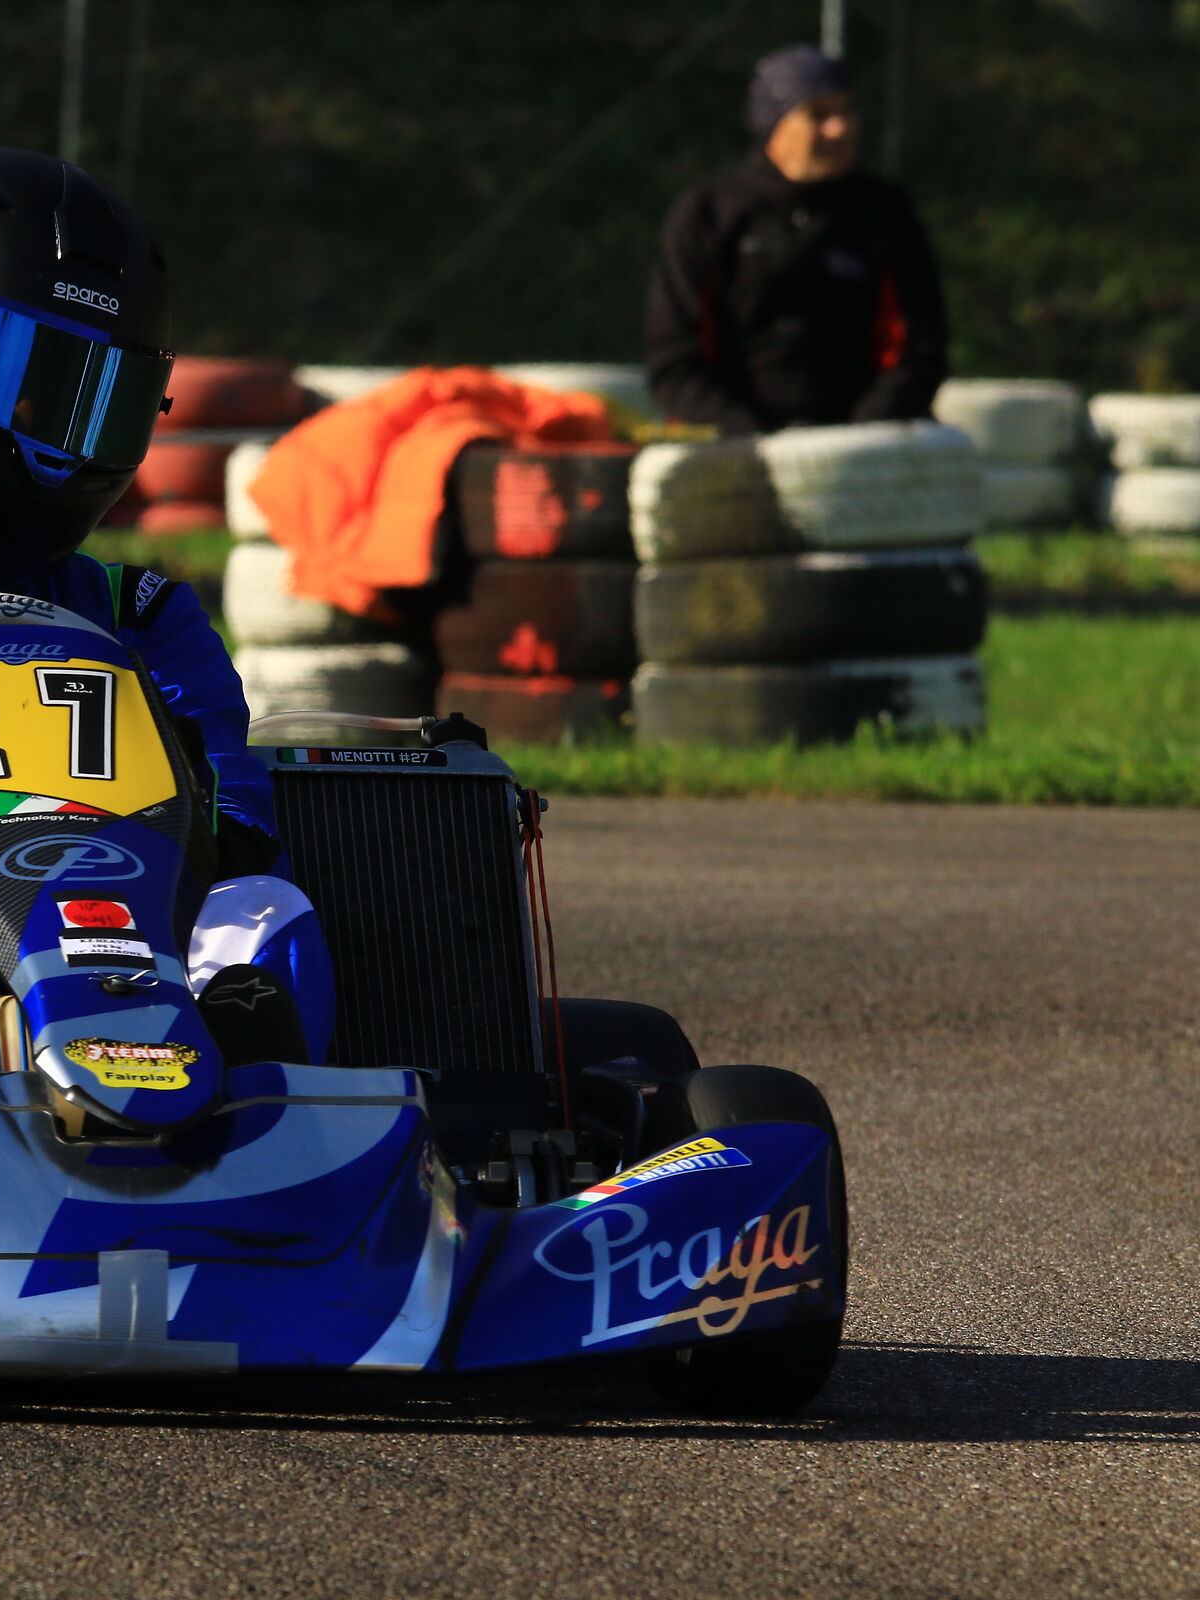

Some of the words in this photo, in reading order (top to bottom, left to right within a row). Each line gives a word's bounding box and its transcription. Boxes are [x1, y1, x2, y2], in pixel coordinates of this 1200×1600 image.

[53, 281, 119, 315] sparco
[331, 751, 395, 763] MENOTTI
[399, 752, 429, 763] #27
[105, 1071, 175, 1083] Fairplay
[634, 1153, 728, 1181] MENOTTI
[533, 1203, 822, 1347] Praga
